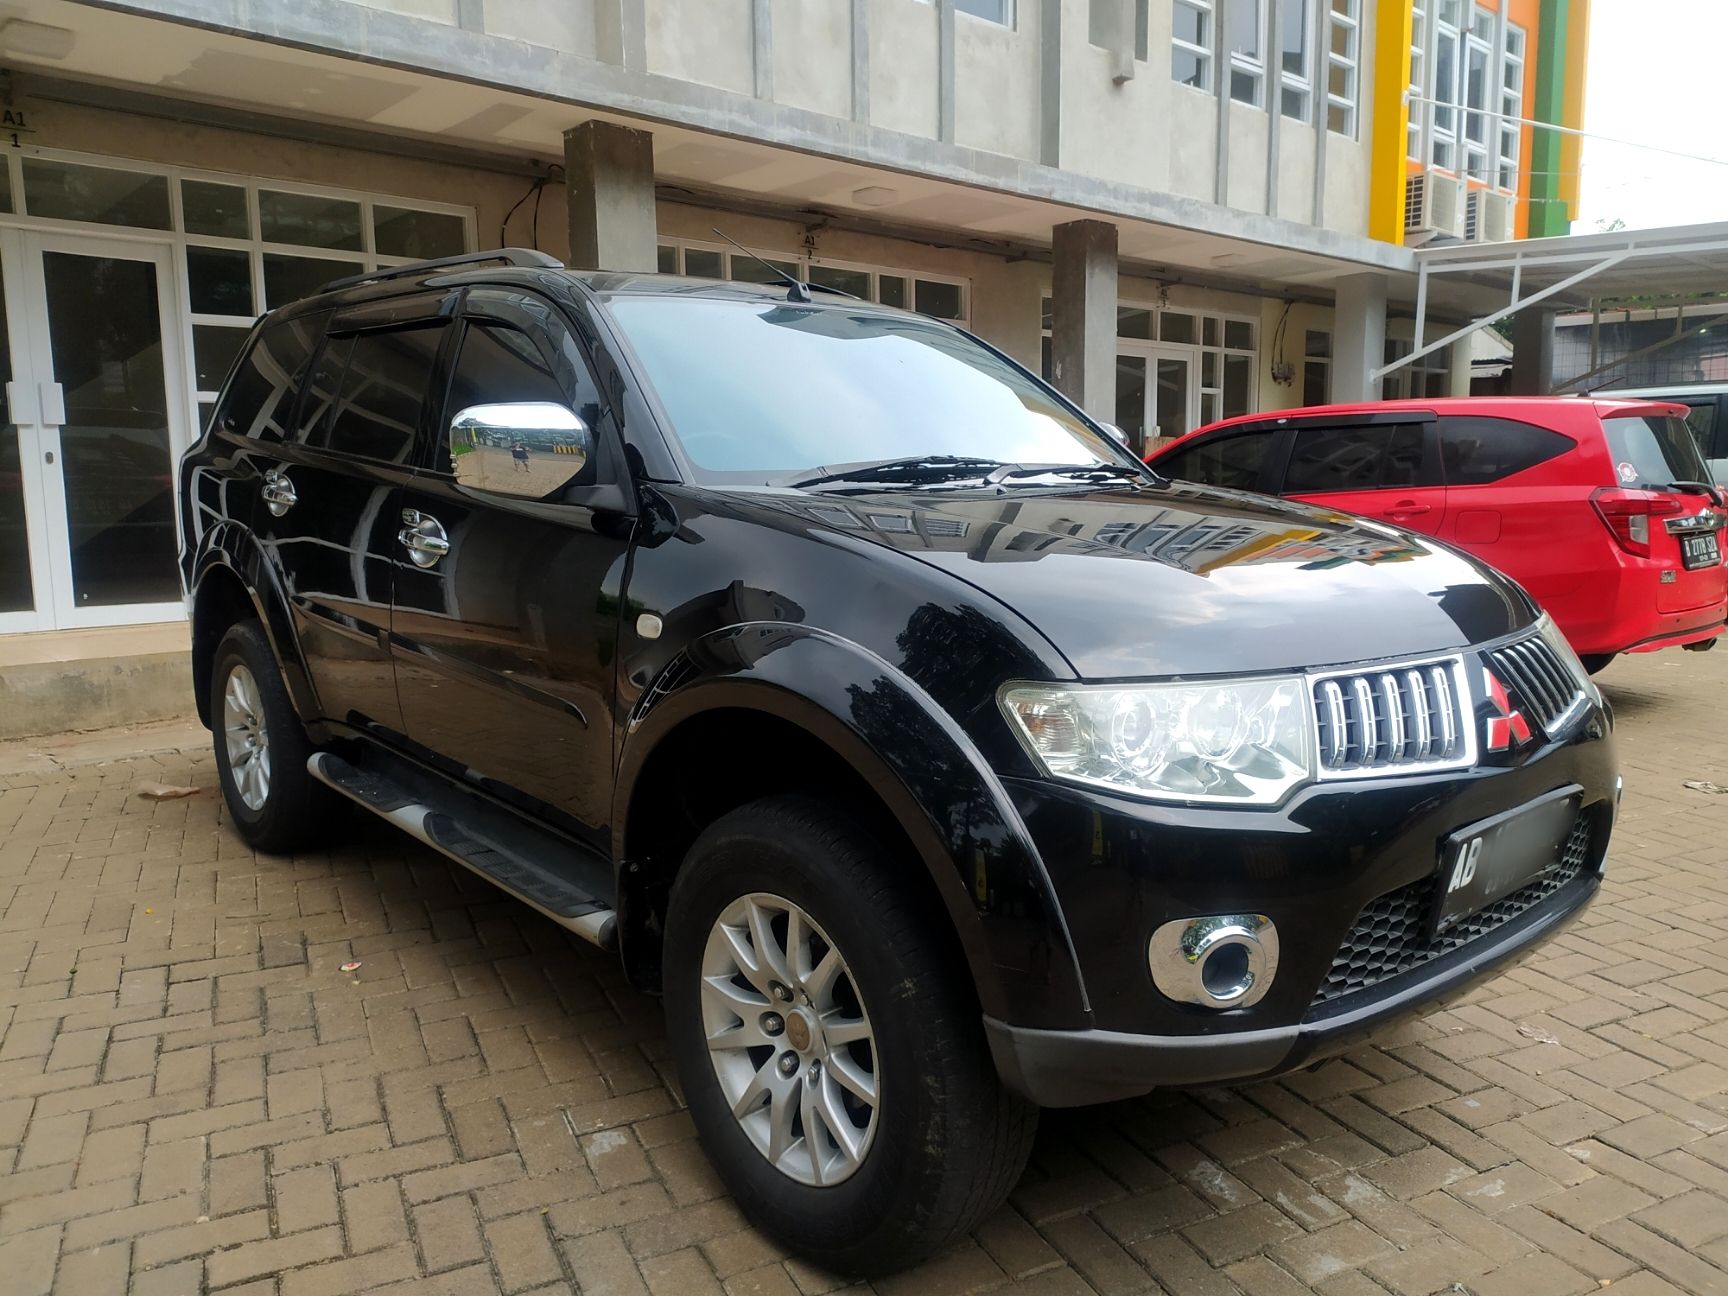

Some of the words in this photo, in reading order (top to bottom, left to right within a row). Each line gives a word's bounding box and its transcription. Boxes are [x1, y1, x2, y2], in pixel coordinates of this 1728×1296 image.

[3, 109, 26, 127] A1
[11, 133, 21, 148] 1
[1448, 836, 1483, 894] AB
